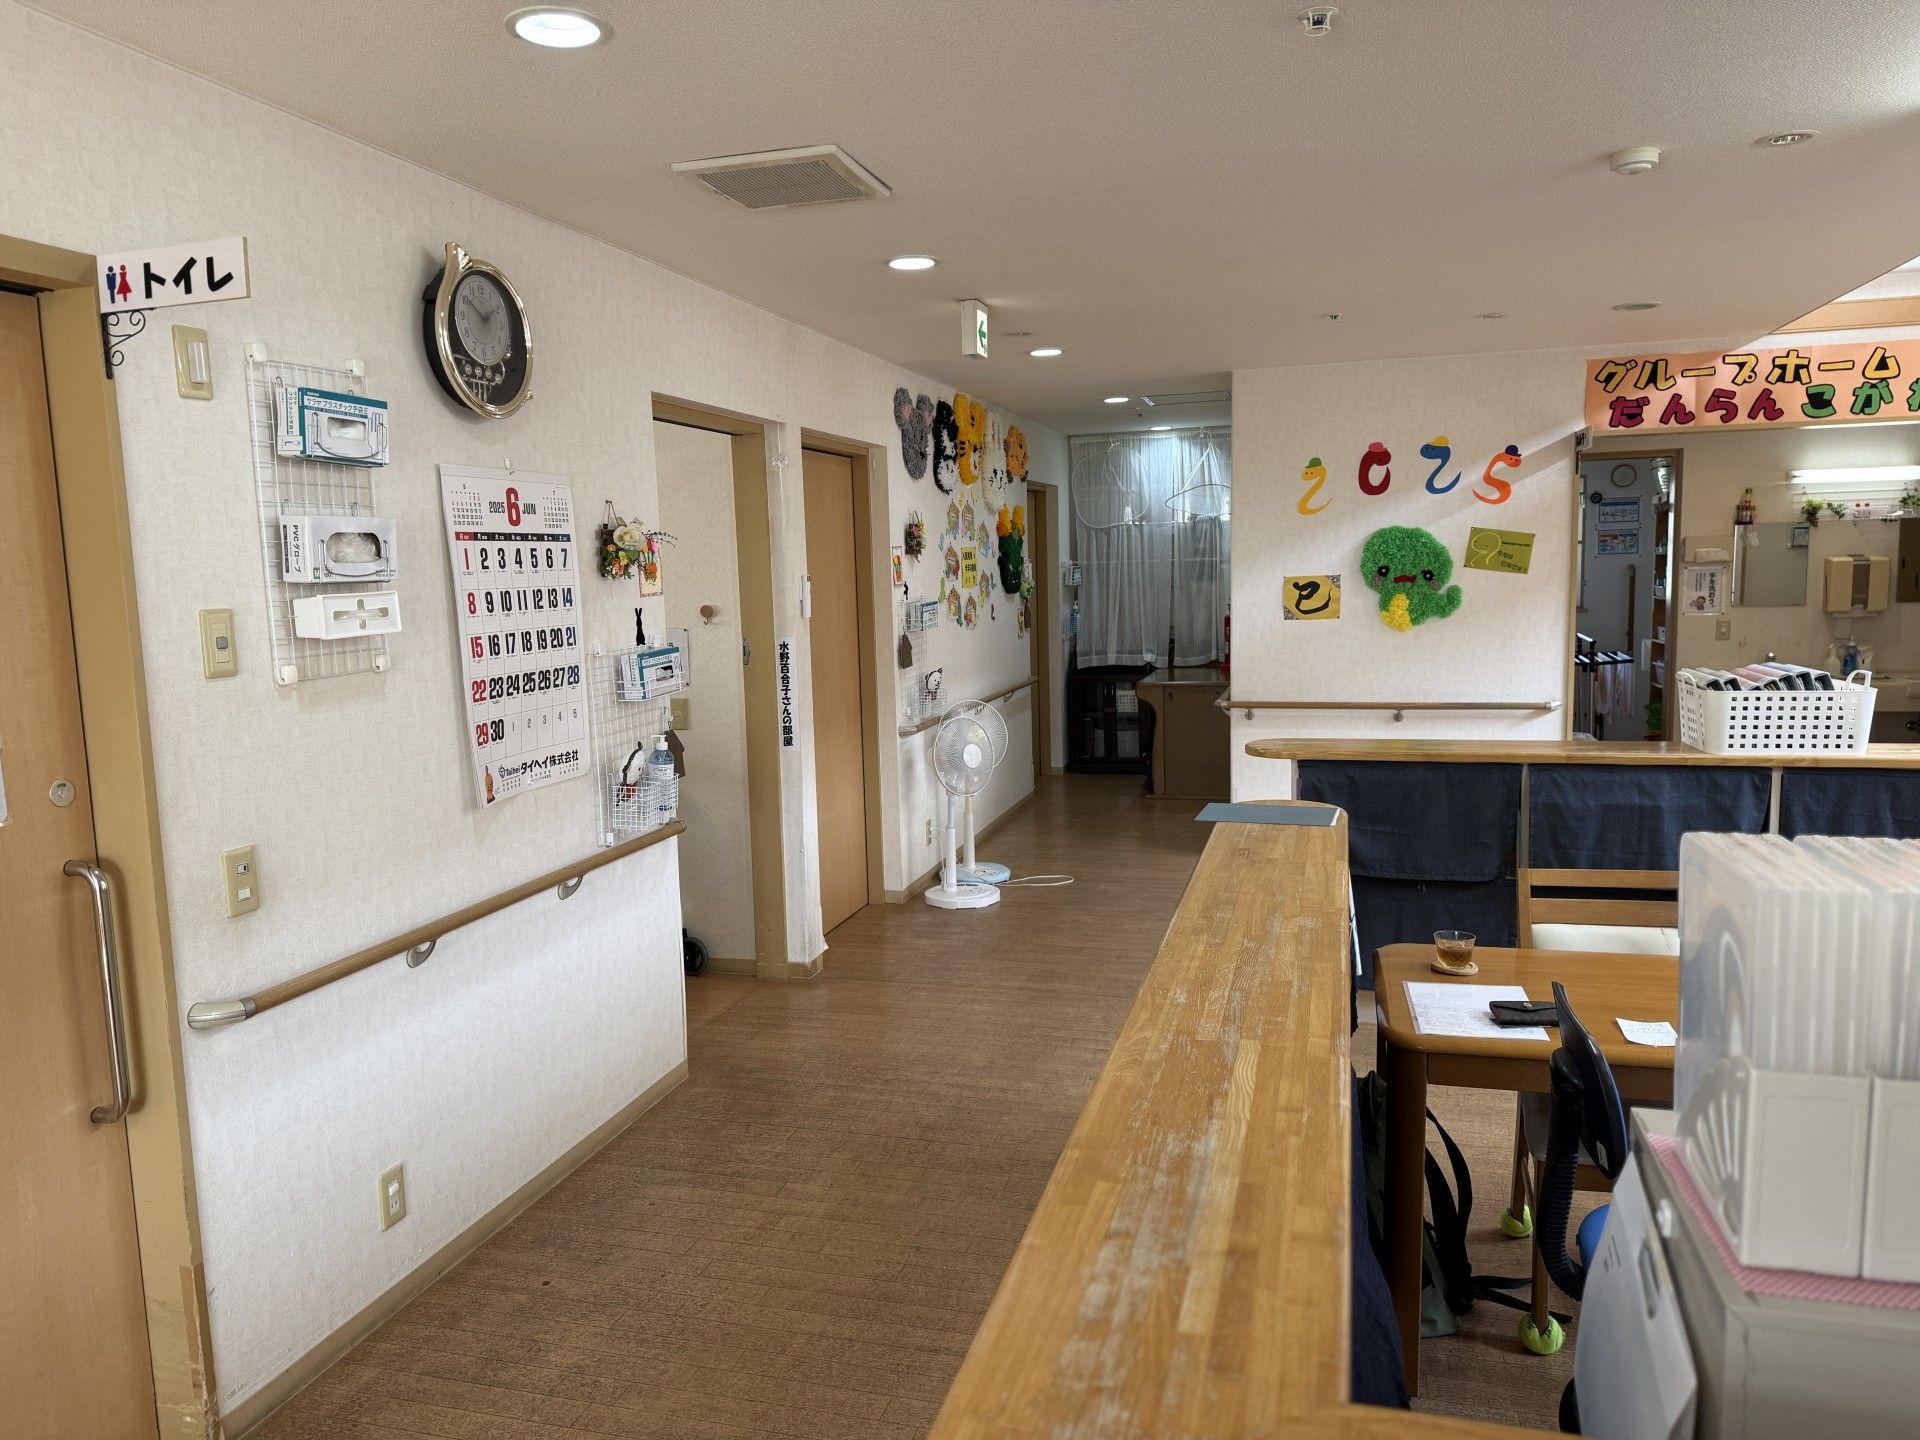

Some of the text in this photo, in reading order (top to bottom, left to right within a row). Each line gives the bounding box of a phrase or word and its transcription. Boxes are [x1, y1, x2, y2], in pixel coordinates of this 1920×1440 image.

[143, 256, 234, 299] トイレ
[1594, 347, 1901, 393] グループホーム
[488, 501, 505, 514] 2025
[506, 487, 521, 527] 6
[522, 502, 537, 515] JUN
[293, 543, 302, 573] グローブ
[464, 547, 568, 570] 1 2 3 4 5 6 7
[467, 587, 573, 615] 8 9 10 11 12 13 14
[470, 626, 577, 659] 15 16 17 18 19 20 21
[471, 664, 580, 703] 22 23 24 25 26 27 28
[778, 640, 794, 747] 水野百合子さんの部屋
[475, 708, 578, 747] 29 30 1 2 3 4 5
[505, 765, 521, 777] Taihei
[520, 749, 579, 775] タイヘイ株式会社
